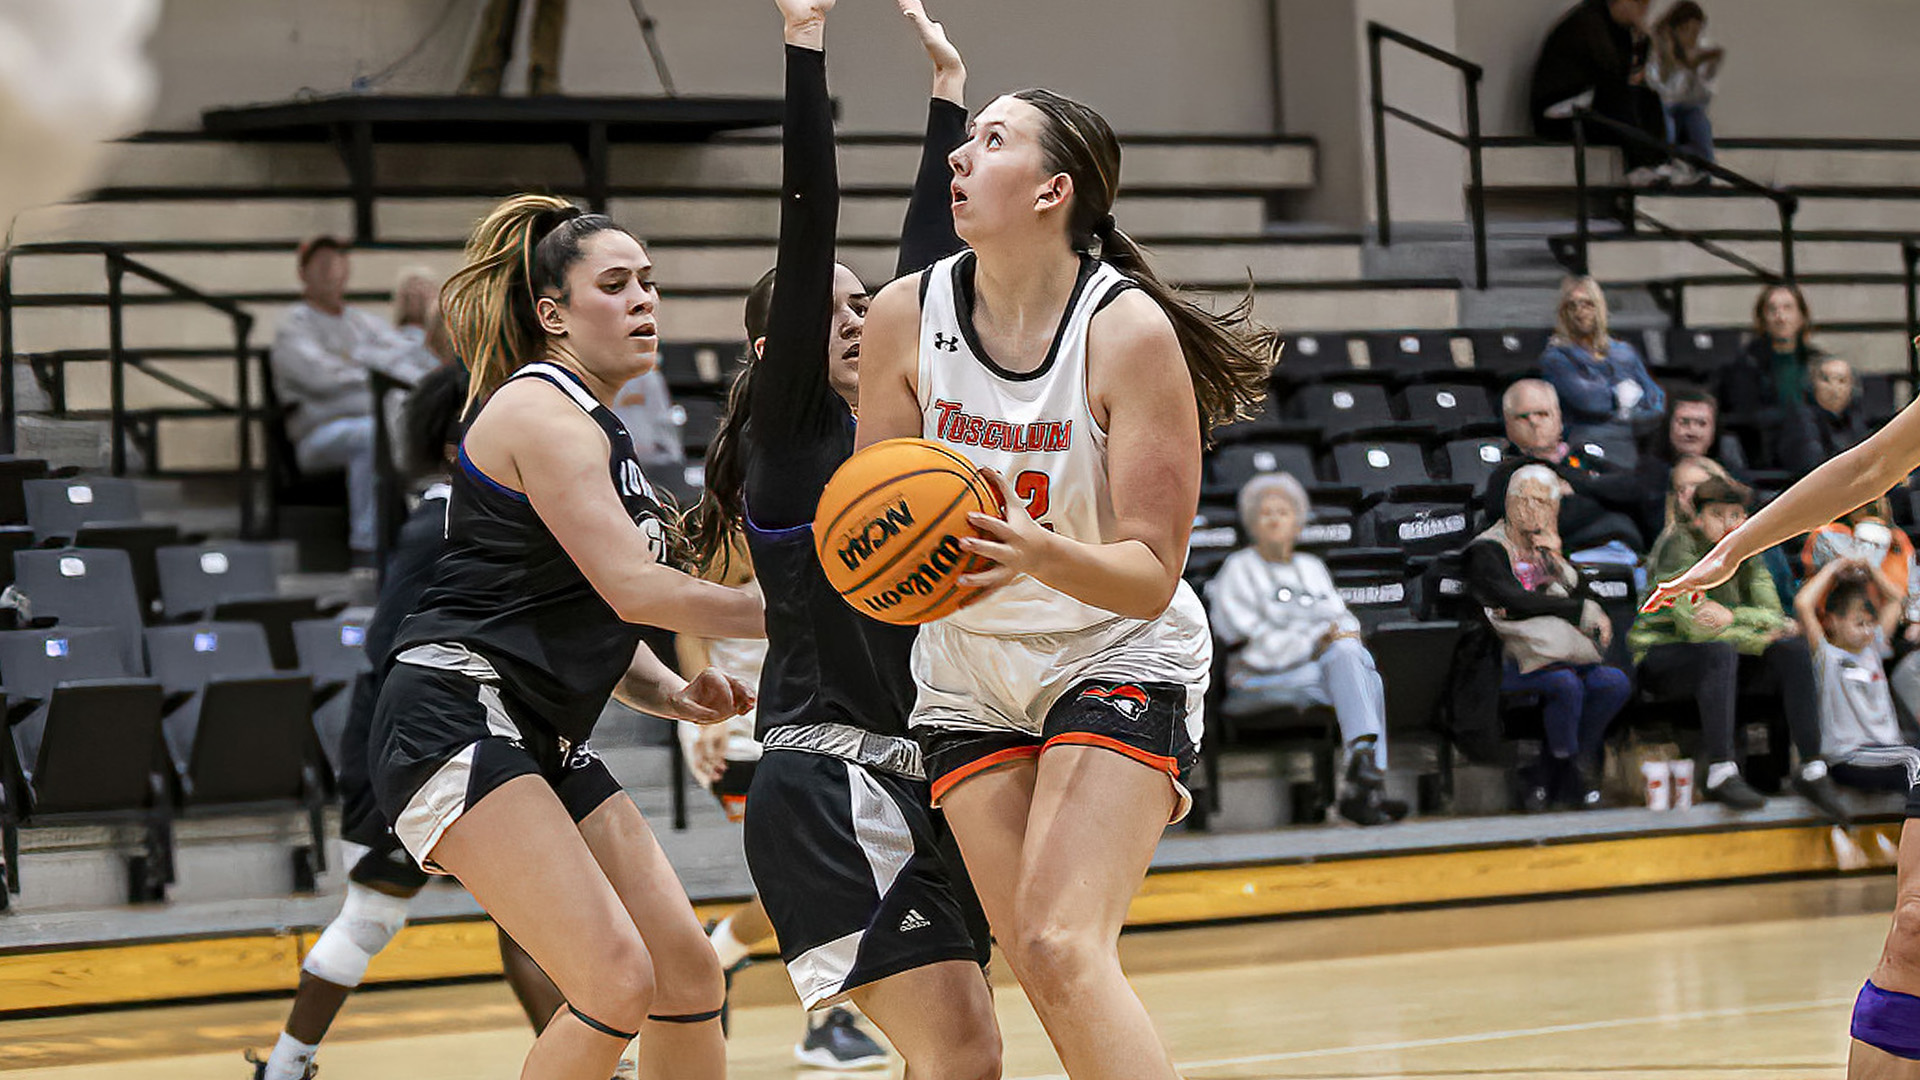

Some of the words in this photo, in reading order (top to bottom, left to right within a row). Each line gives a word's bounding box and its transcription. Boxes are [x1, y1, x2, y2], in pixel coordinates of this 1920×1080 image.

[935, 398, 1073, 452] TUSCULUM
[838, 499, 915, 571] NCAA
[864, 534, 963, 611] Wilson
